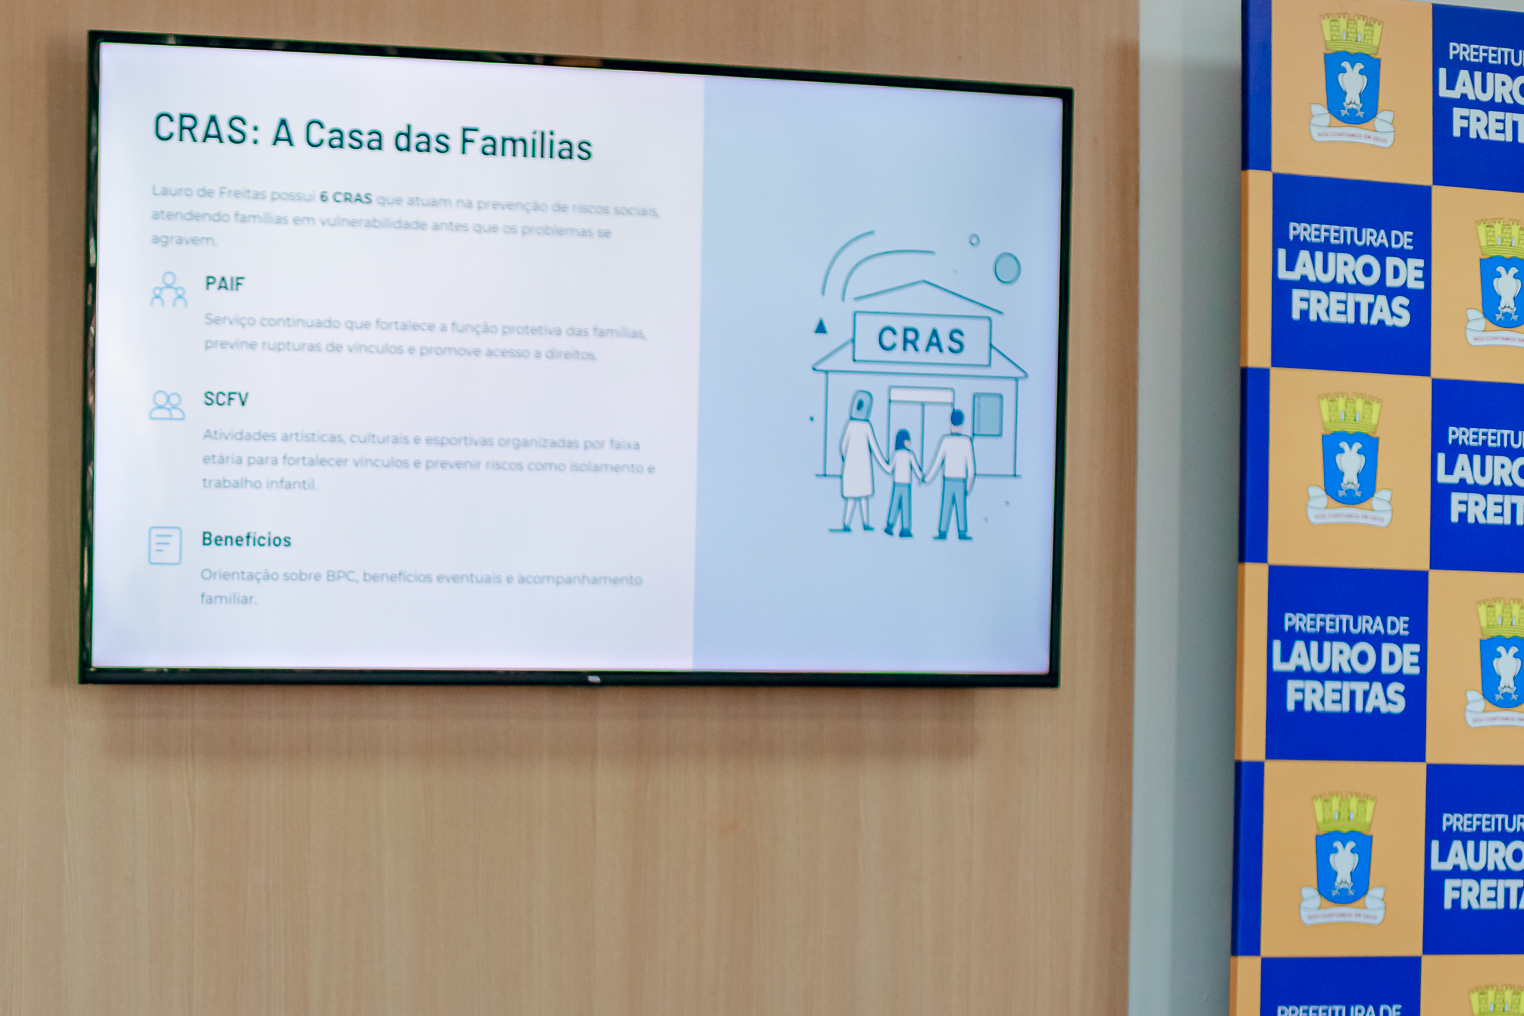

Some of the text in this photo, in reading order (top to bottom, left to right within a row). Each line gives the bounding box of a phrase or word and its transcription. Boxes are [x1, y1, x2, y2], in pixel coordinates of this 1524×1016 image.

[1450, 43, 1524, 66] PREFEITU
[154, 111, 591, 160] CRAS: A Casa das Famílias
[1453, 107, 1524, 143] FREIT
[151, 183, 659, 218] Lauro de Freitas possui 6 CRAS que atuam na prevenção de riscos sociais,
[150, 209, 230, 222] atendendo
[291, 215, 316, 226] em
[319, 215, 428, 230] vulnerabilidade
[431, 221, 469, 232] antes
[472, 223, 499, 234] que
[502, 224, 517, 234] os
[520, 225, 594, 238] problemas
[597, 228, 612, 238] se
[150, 234, 217, 247] agravem.
[1290, 223, 1413, 249] PREFEITURA DE
[1278, 249, 1424, 289] LAURO DE
[205, 275, 245, 291] PAIF
[1292, 289, 1410, 327] FREITAS
[204, 312, 256, 328] Serviço
[259, 316, 341, 329] continuado
[343, 319, 372, 331] que
[374, 317, 435, 332] fortalece
[439, 322, 447, 332] a
[450, 319, 498, 336] função
[501, 324, 562, 336] protetiva
[565, 325, 589, 337] das
[204, 339, 257, 351] previne
[261, 340, 322, 353] rupturas
[324, 340, 343, 353] de
[407, 345, 415, 355] e
[419, 345, 482, 357] promove
[484, 347, 530, 359] acesso
[533, 349, 541, 359] a
[544, 348, 597, 361] direitos.
[878, 325, 964, 354] CRAS
[203, 390, 248, 406] SCFV
[202, 428, 277, 441] Atividades
[349, 432, 410, 444] culturais
[412, 435, 421, 445] e
[424, 435, 494, 447] esportivas
[497, 437, 580, 450] organizadas
[583, 439, 604, 451] por
[609, 437, 640, 450] faixa
[1449, 427, 1524, 448] PREFEITU
[202, 453, 242, 465] etária
[246, 455, 278, 467] para
[282, 453, 348, 467] fortalecer
[412, 458, 421, 469] e
[425, 459, 480, 470] prevenir
[485, 460, 523, 471] riscos
[526, 461, 566, 471] como
[569, 460, 644, 473] isolamento
[647, 464, 655, 474] e
[201, 476, 317, 490] trabalho infantil.
[1451, 492, 1524, 525] FREIT
[202, 531, 291, 547] Benefícios
[200, 568, 279, 584] Orientação
[282, 569, 322, 581] sobre
[326, 569, 359, 583] BPC,
[436, 572, 502, 584] eventuais
[505, 574, 514, 584] e
[517, 574, 642, 586] acompanhamento
[200, 591, 257, 605] familiar.
[1285, 613, 1409, 635] PREFEITURA DE
[1273, 640, 1420, 674] LAURO DE
[1287, 680, 1405, 713] FREITAS
[1443, 814, 1524, 831] PREFEITUR
[1444, 879, 1524, 909] FREIT
